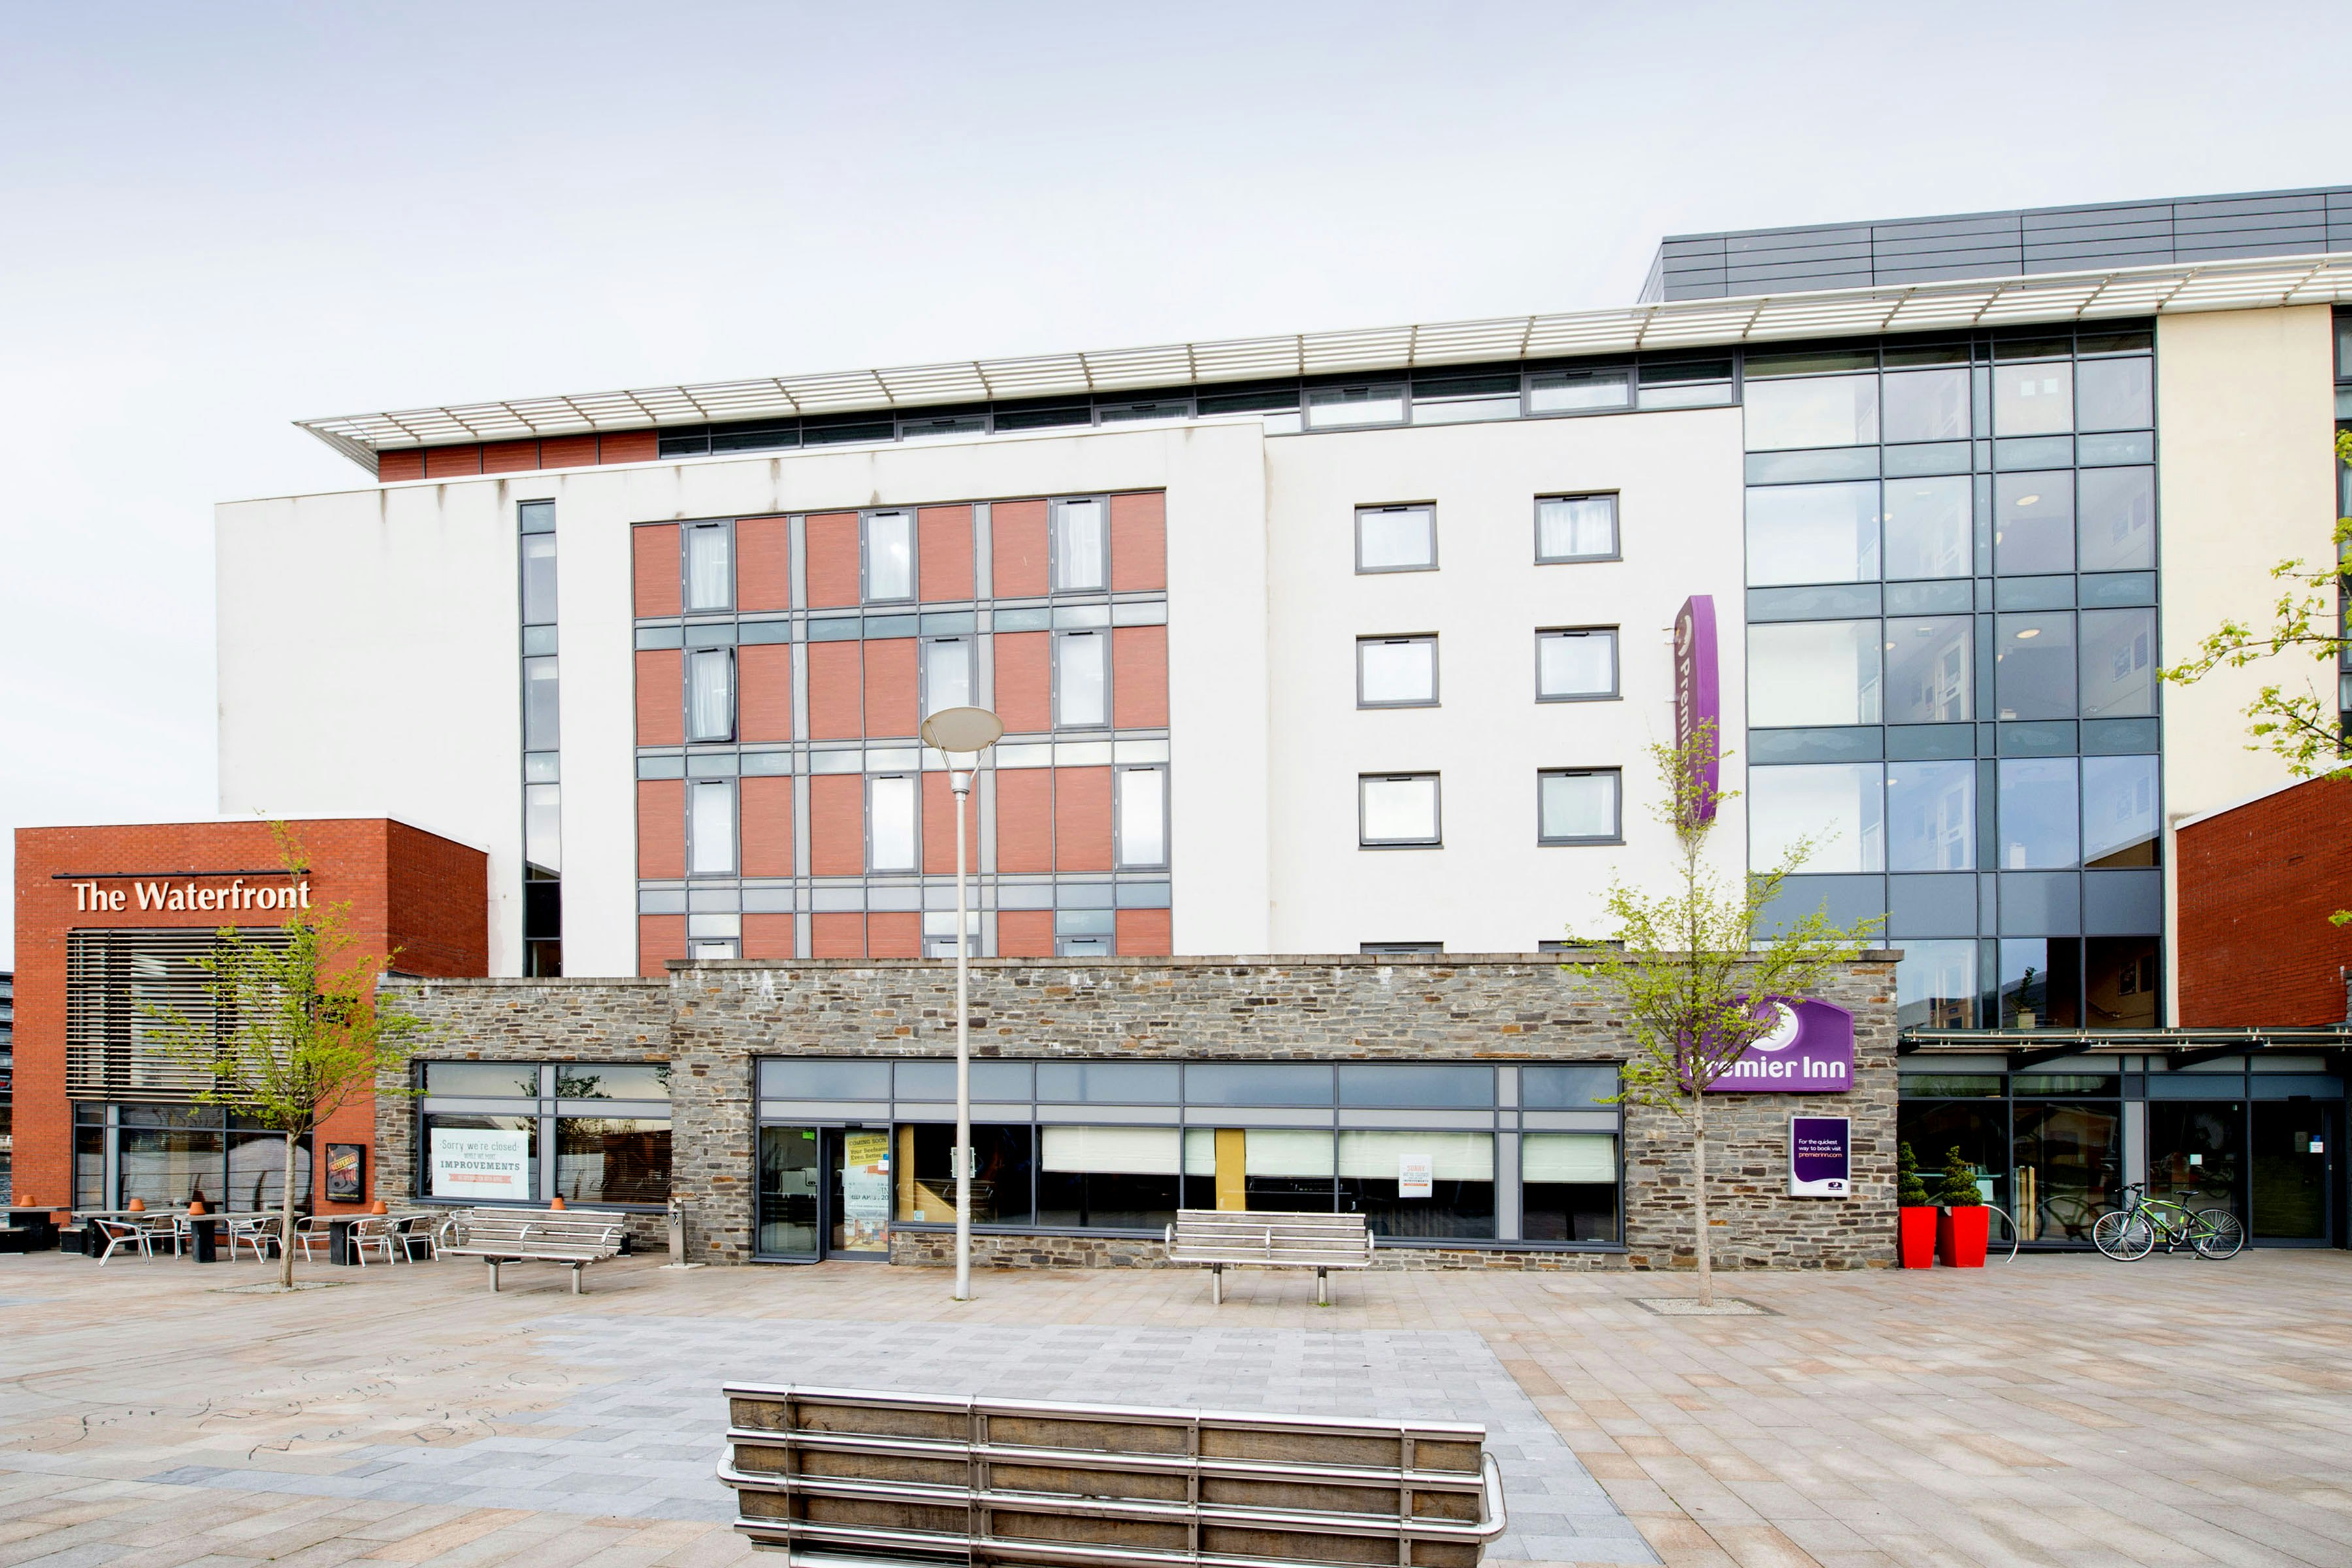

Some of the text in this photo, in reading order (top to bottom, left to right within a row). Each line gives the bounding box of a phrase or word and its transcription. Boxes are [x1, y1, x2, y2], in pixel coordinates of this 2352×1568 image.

[71, 879, 311, 911] The Waterfront
[1803, 1056, 1846, 1078] Inn
[441, 1139, 517, 1152] Sorry we're closed
[440, 1161, 521, 1171] IMPROVEMENTS
